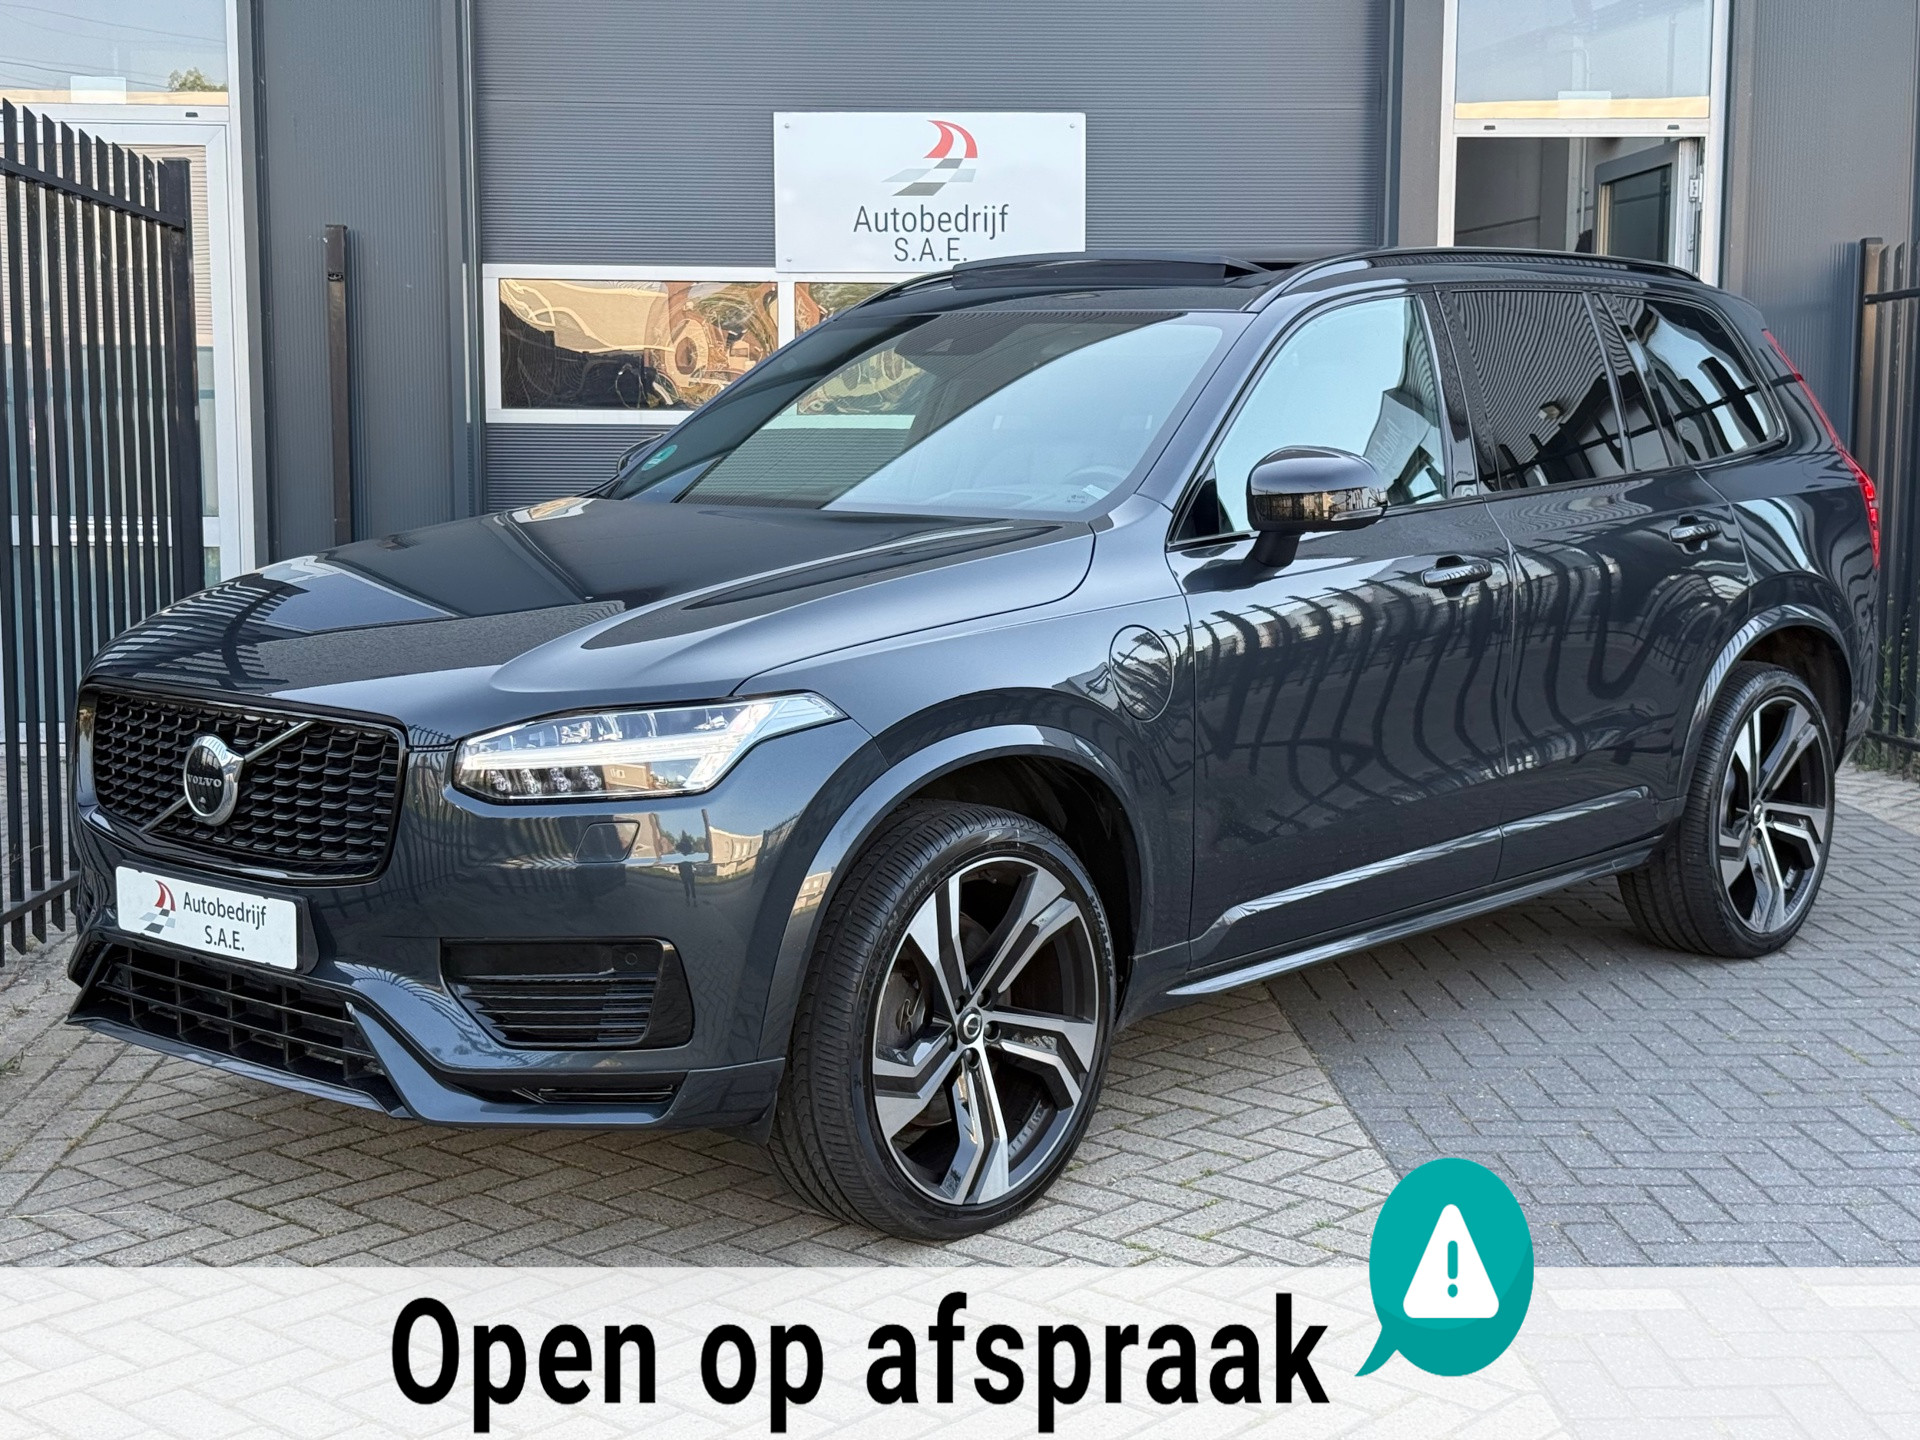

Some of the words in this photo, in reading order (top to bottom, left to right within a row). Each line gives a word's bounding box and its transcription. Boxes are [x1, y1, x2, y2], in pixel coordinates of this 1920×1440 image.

[853, 203, 1010, 240] Autobedrijf
[894, 237, 968, 262] S.A.E.
[187, 773, 222, 788] VOLVO
[183, 891, 267, 930] Autobedrijf
[204, 925, 245, 952] S.A.E.
